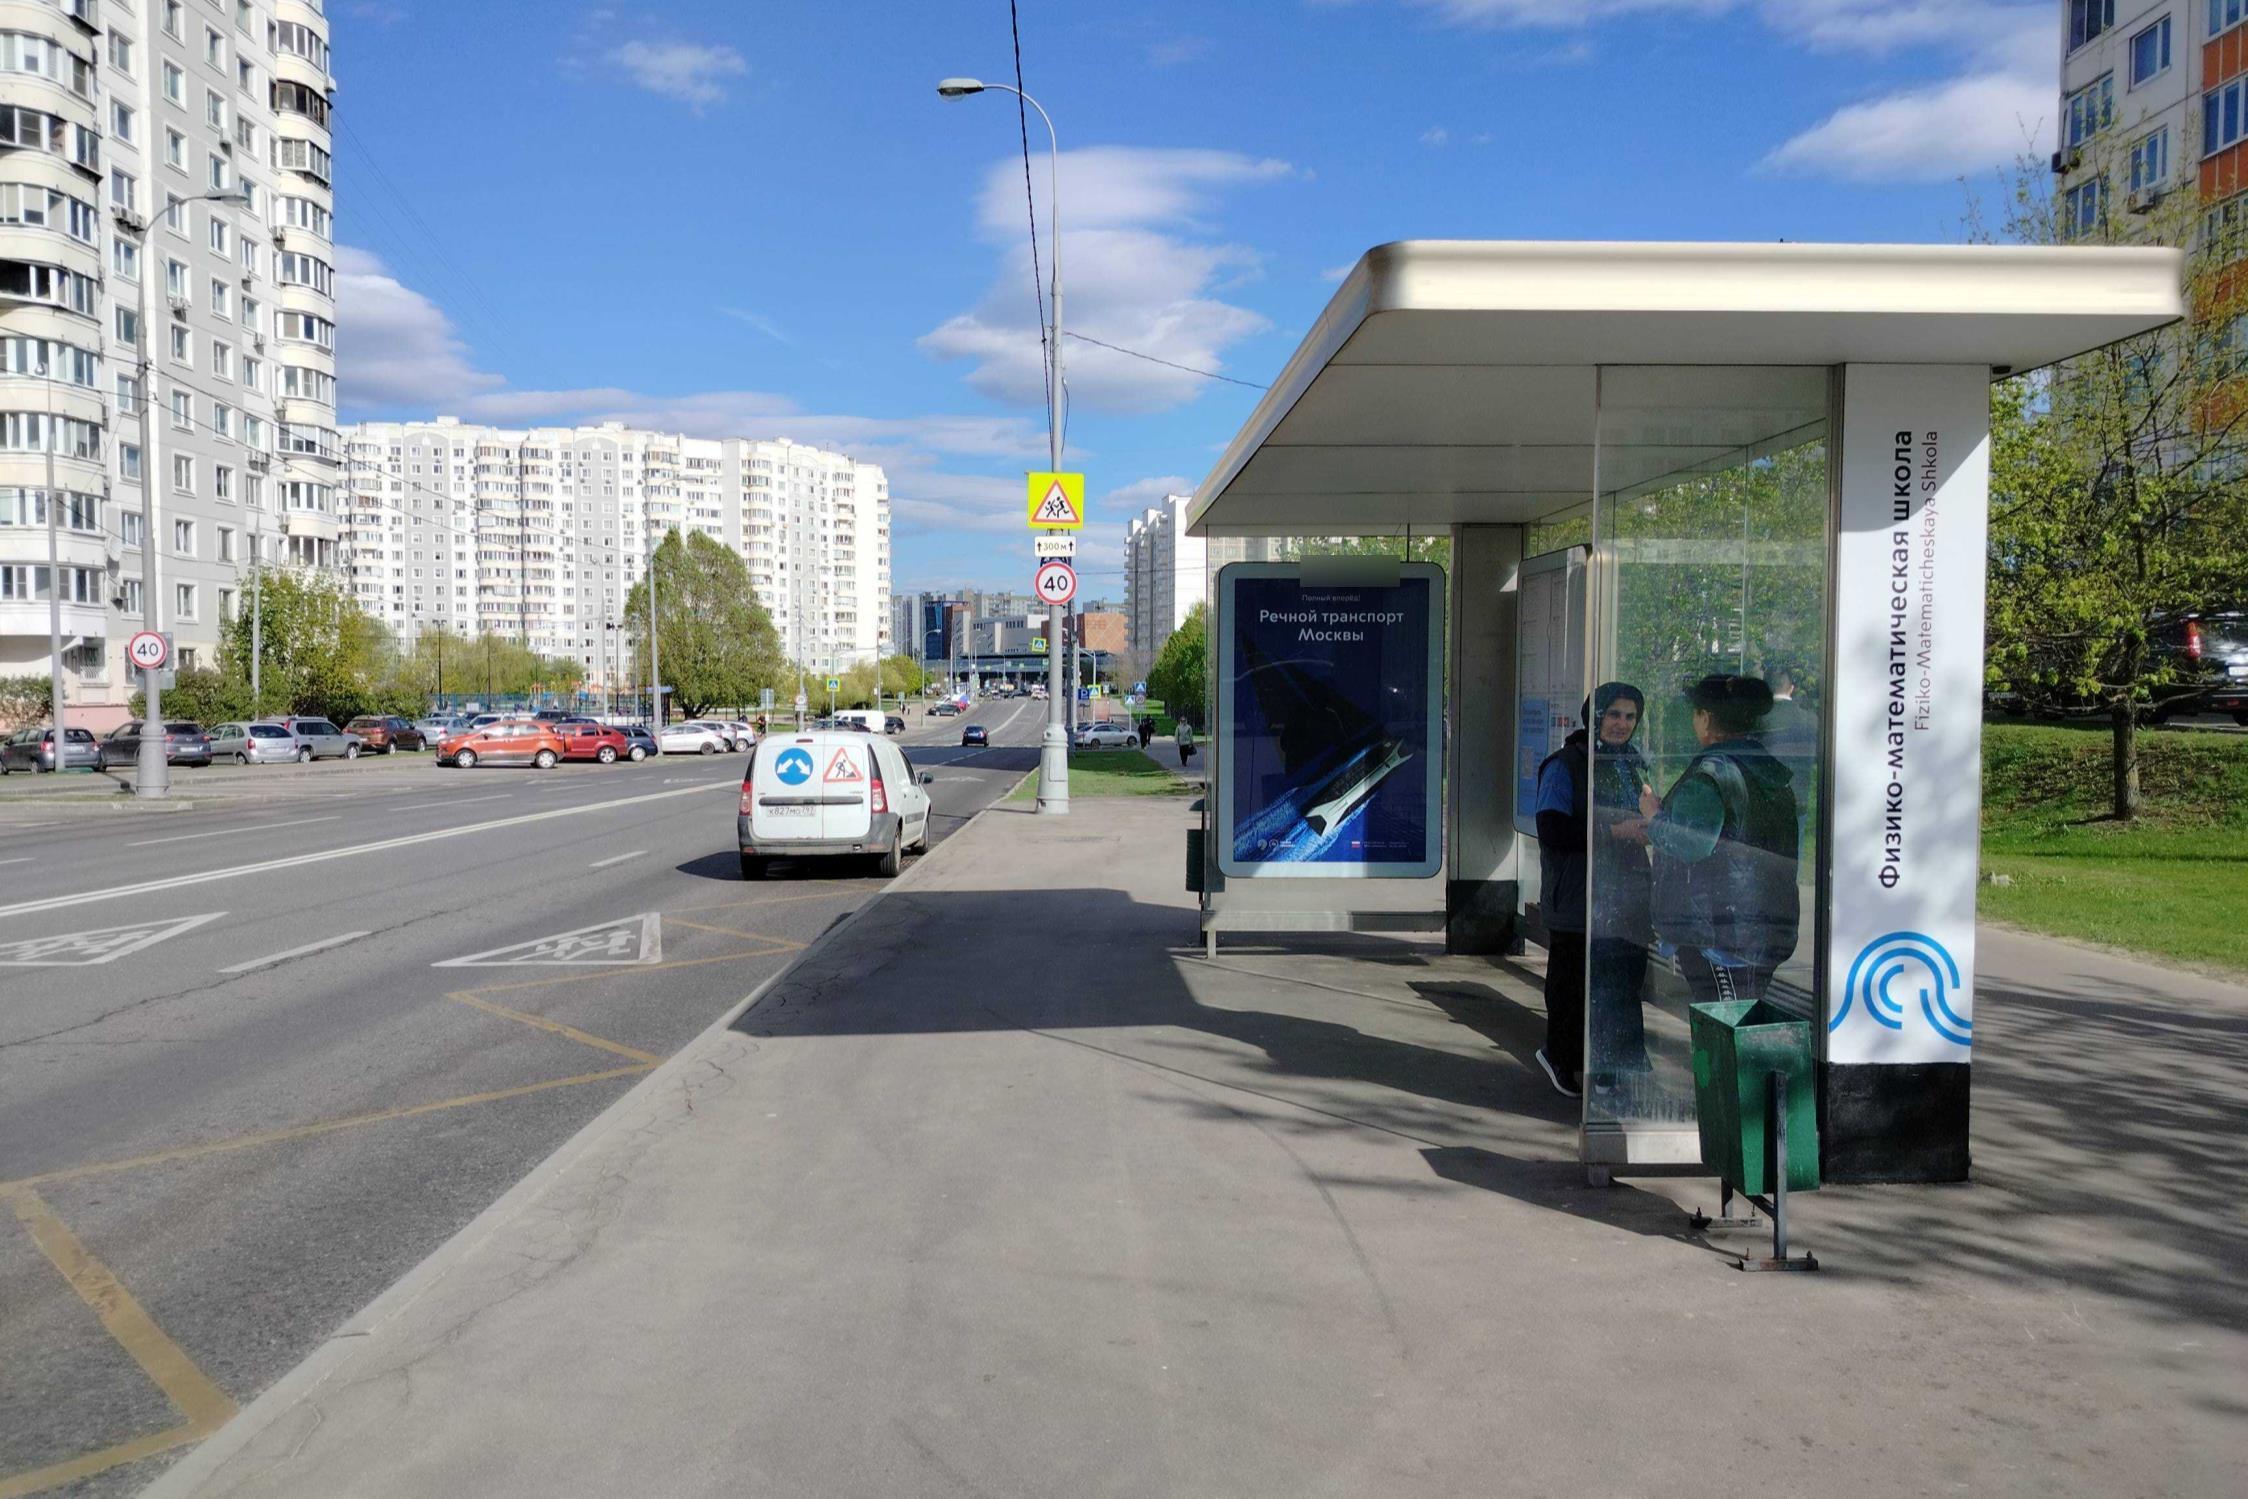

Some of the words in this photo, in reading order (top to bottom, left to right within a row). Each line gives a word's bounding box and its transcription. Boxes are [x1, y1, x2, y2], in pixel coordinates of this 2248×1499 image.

[1893, 430, 1912, 521] школа
[1921, 431, 1938, 492] Shkola
[1044, 575, 1068, 592] 40
[1259, 609, 1318, 623] Речной
[1322, 611, 1404, 626] транспорт
[1914, 497, 1939, 731] Fiziko-Matematicheskaya
[137, 642, 159, 657] 40
[1298, 627, 1364, 642] Москвы
[1878, 531, 1909, 889] Физико-математическая
